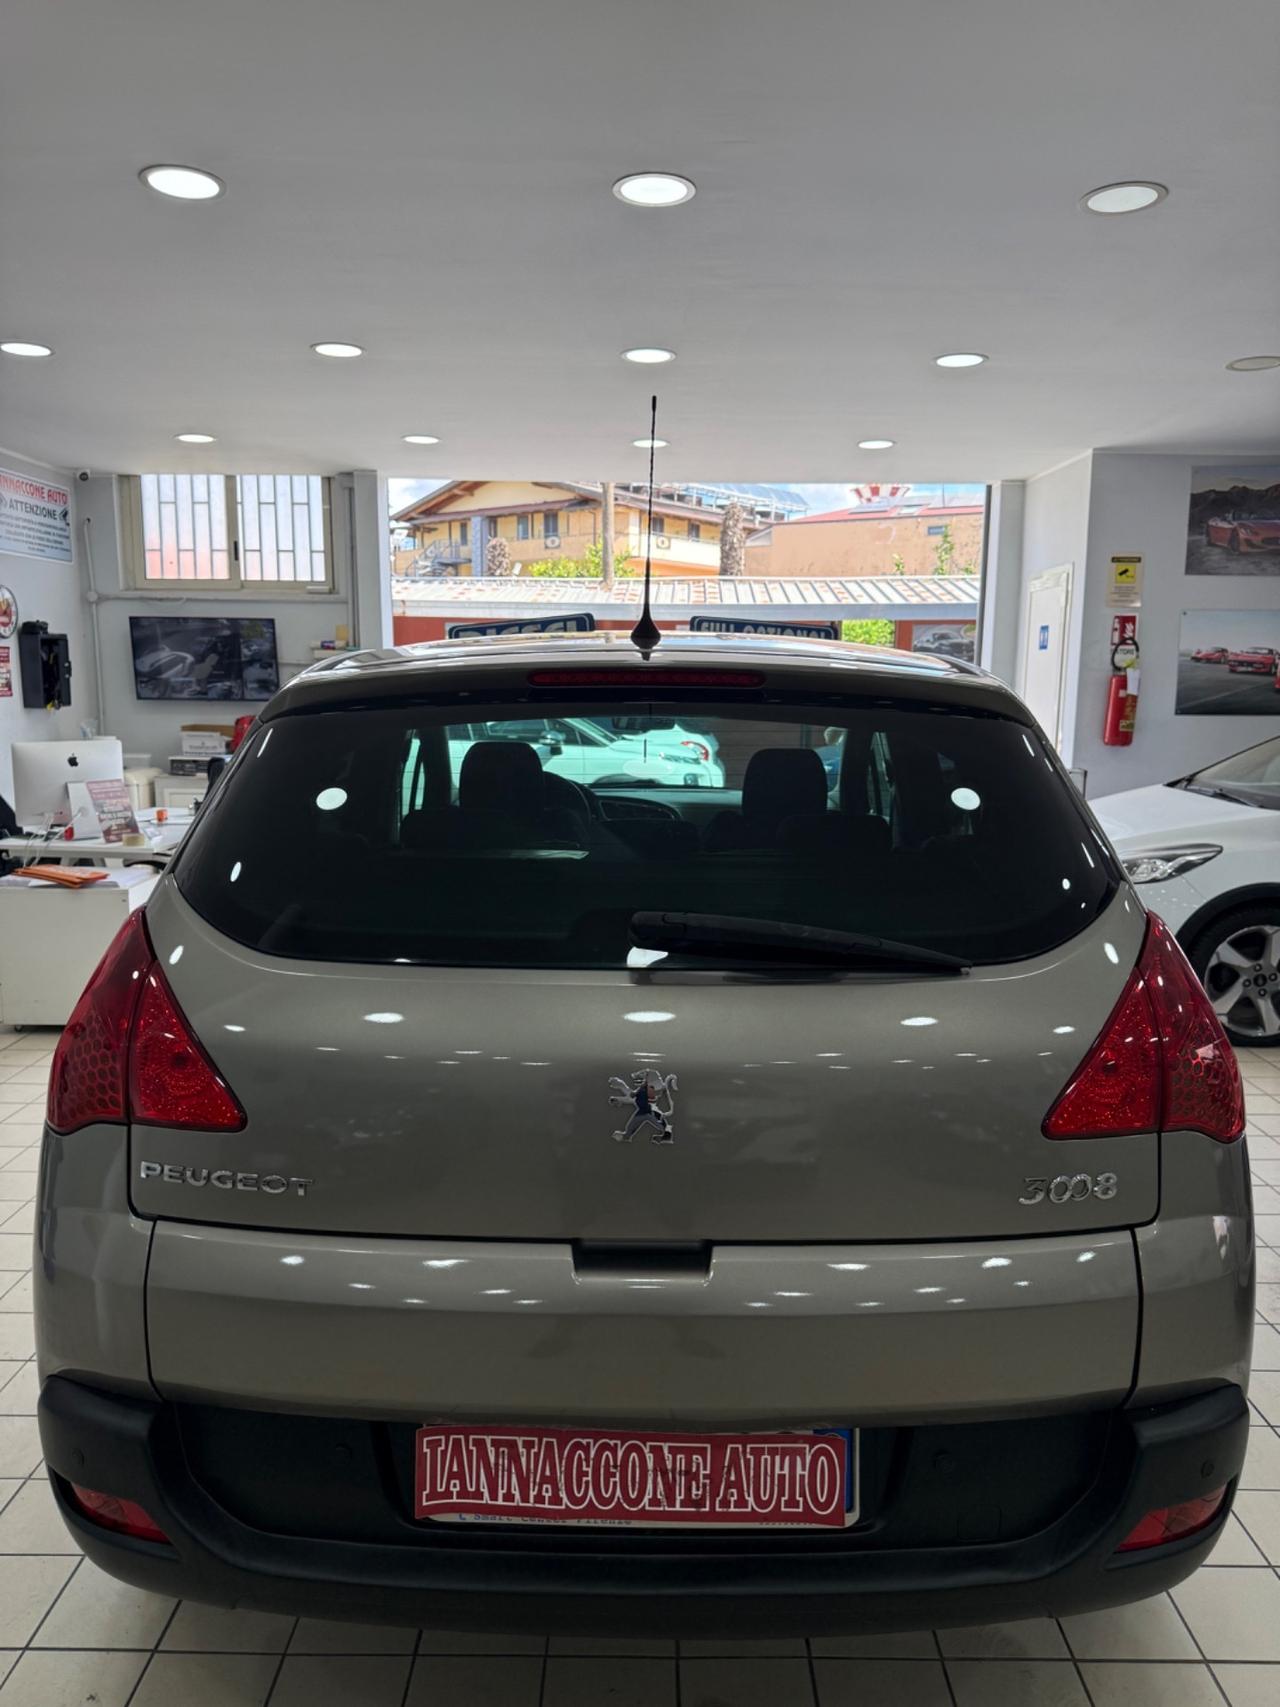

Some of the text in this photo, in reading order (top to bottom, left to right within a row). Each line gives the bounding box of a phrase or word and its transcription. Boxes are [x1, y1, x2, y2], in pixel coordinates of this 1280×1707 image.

[9, 498, 58, 520] ATTENZIONE
[47, 489, 68, 506] AUTO
[140, 1160, 313, 1196] PEUGEOT
[1018, 1172, 1118, 1205] 3008
[422, 1434, 841, 1515] IANNACCONE AUTO
